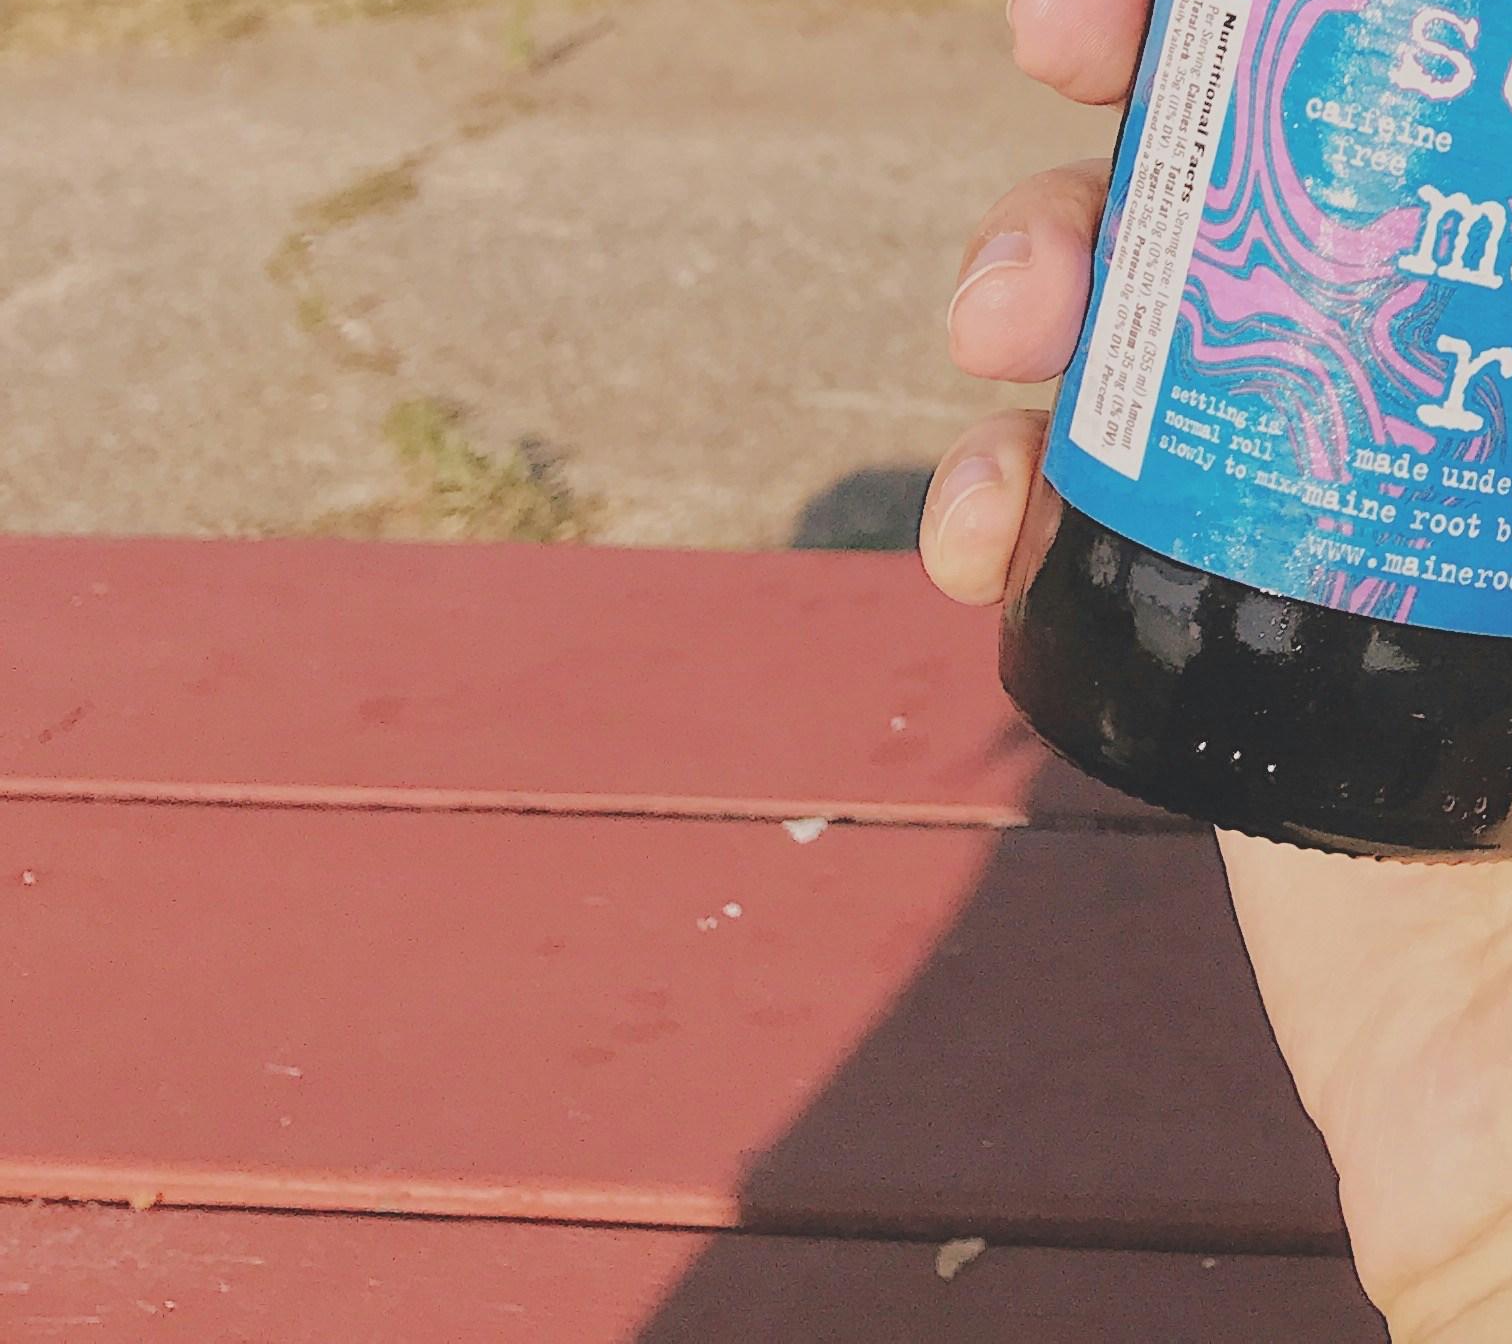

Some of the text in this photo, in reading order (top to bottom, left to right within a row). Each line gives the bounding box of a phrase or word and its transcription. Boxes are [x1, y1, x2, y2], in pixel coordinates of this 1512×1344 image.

[1204, 4, 1220, 27] Per
[1164, 26, 1182, 68] Values
[1159, 70, 1170, 91] are
[1197, 12, 1236, 136] Nutritional
[1149, 93, 1166, 131] based
[1178, 82, 1200, 133] Calories
[1306, 97, 1452, 153] caffeine
[1180, 140, 1205, 204] Facts
[1331, 132, 1407, 175] free
[1132, 160, 1149, 199] 2000
[1143, 157, 1165, 202] Sugars
[1163, 164, 1181, 197] Total
[1122, 199, 1139, 243] calorie
[1157, 197, 1172, 220] Fat
[1163, 208, 1189, 258] Serving
[1126, 234, 1146, 280] Protein
[1125, 302, 1147, 349] Sodium
[1147, 299, 1168, 338] bottle
[1120, 350, 1136, 370] 35
[1137, 339, 1158, 373] (355
[1093, 363, 1114, 416] Percent
[1112, 369, 1128, 391] mg
[1130, 372, 1150, 397] ml)
[1119, 398, 1143, 450] Amount
[1171, 385, 1248, 429] settling
[1100, 419, 1120, 450] DV).
[1165, 409, 1272, 461] normal roll
[1158, 434, 1217, 471] slowly
[1225, 455, 1247, 479] to
[1353, 448, 1429, 481] made
[1302, 483, 1396, 523] maine
[1409, 509, 1481, 538] root
